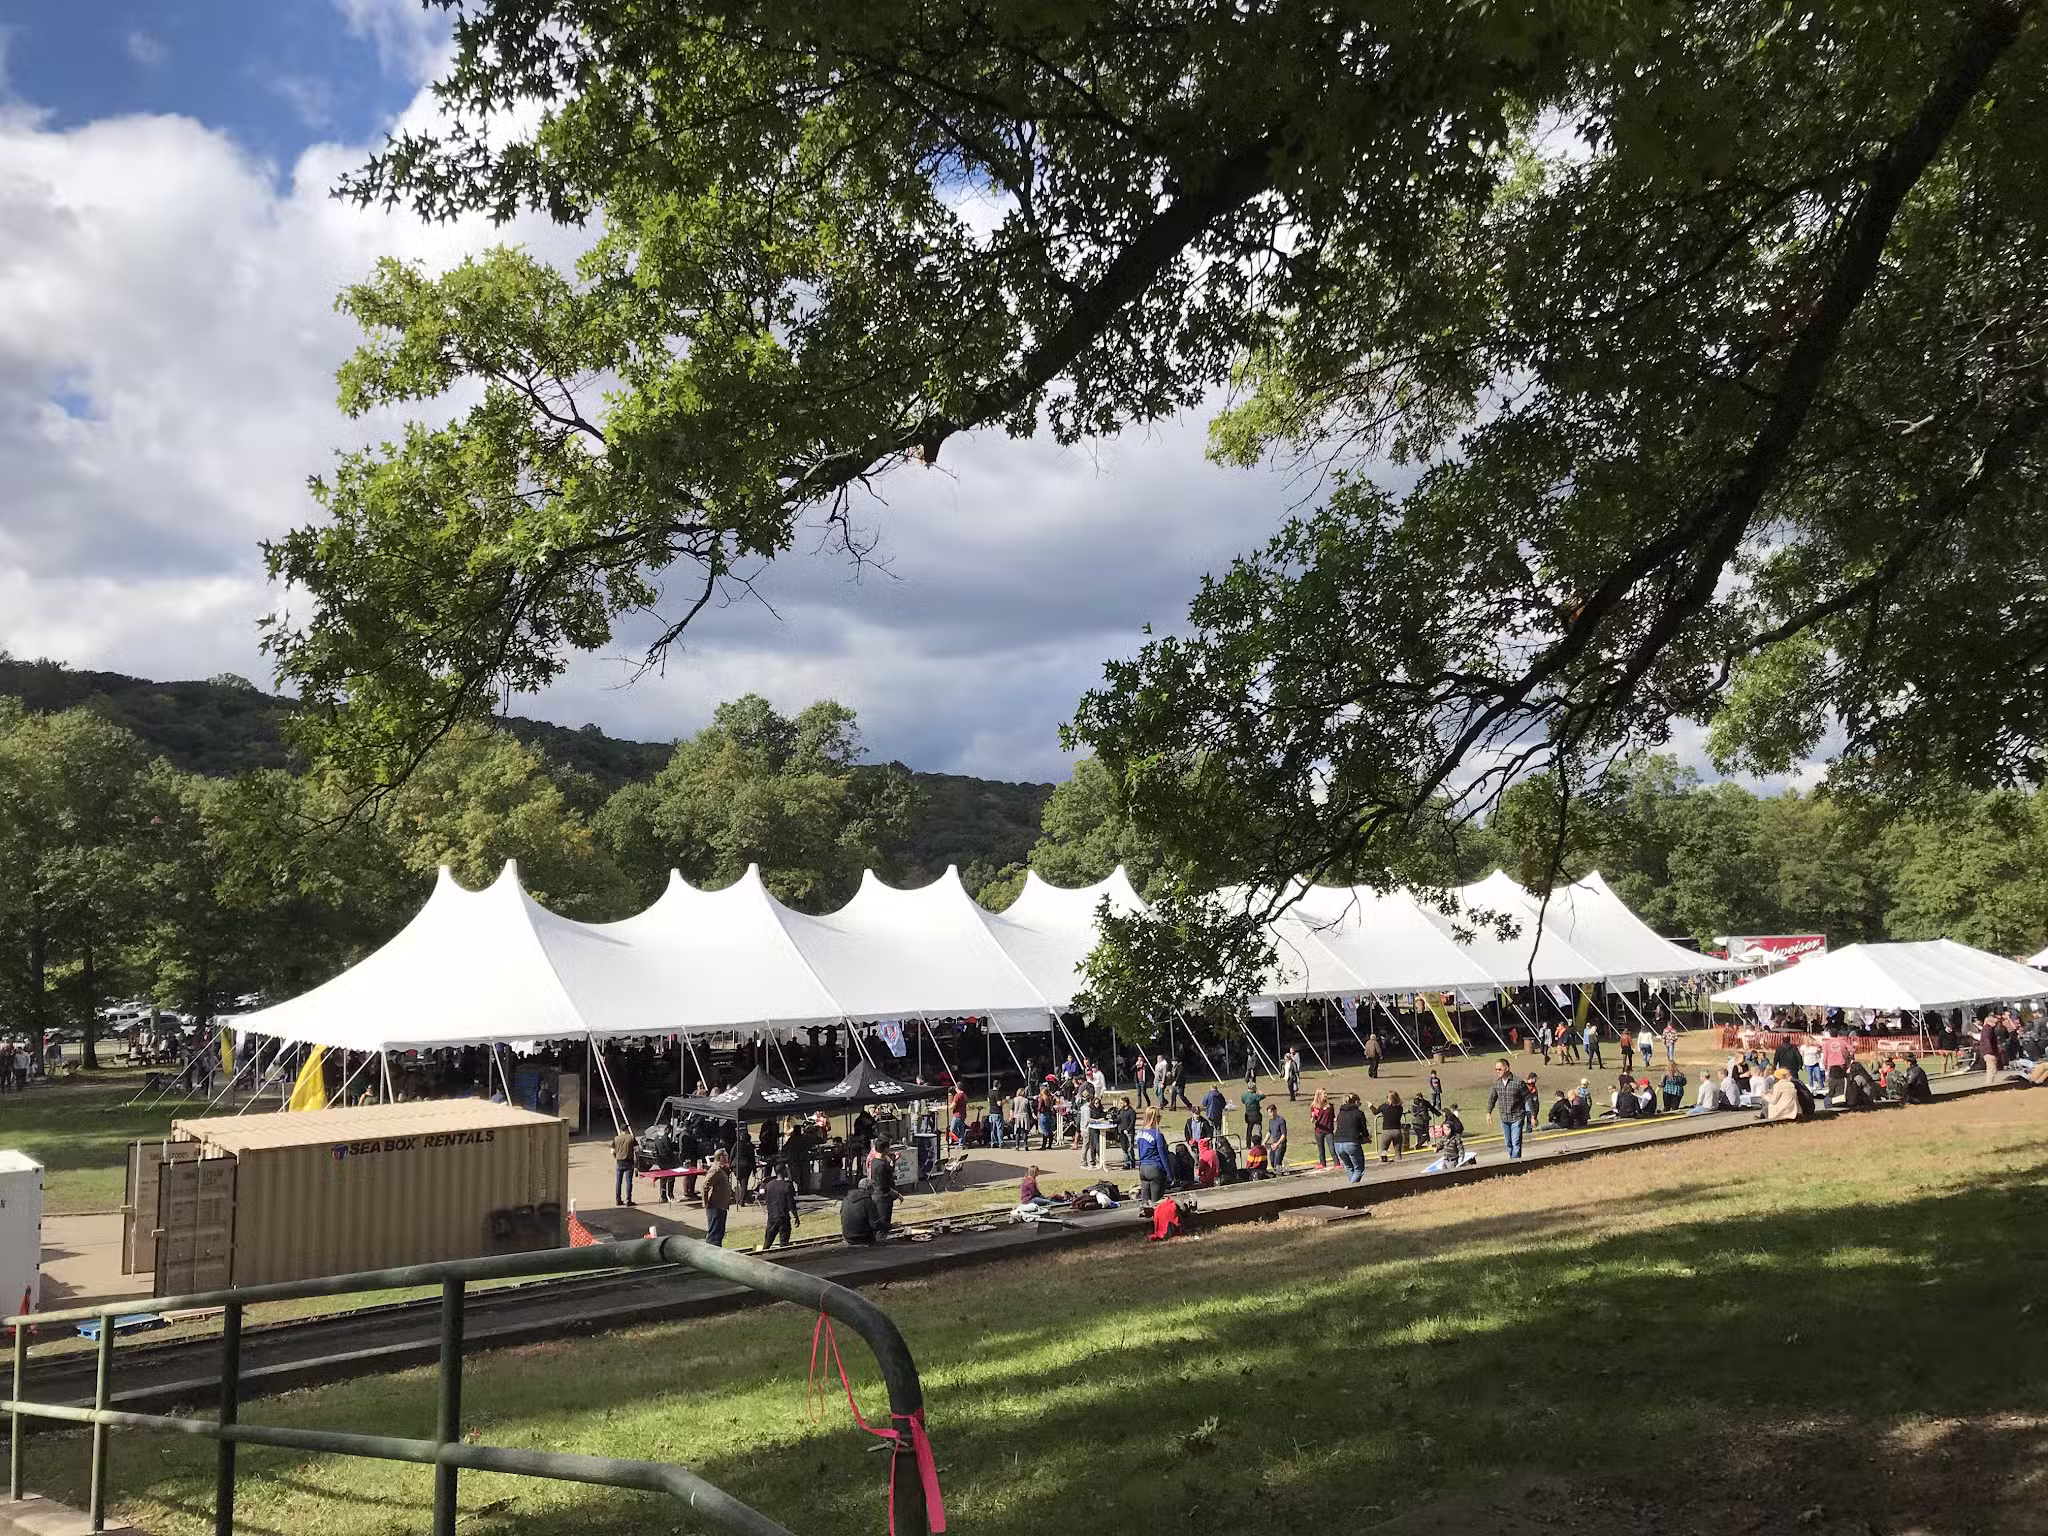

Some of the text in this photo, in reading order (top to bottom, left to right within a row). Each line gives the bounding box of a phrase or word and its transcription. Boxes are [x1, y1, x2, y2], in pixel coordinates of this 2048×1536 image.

[350, 1130, 495, 1156] SEA BOX RENTALS
